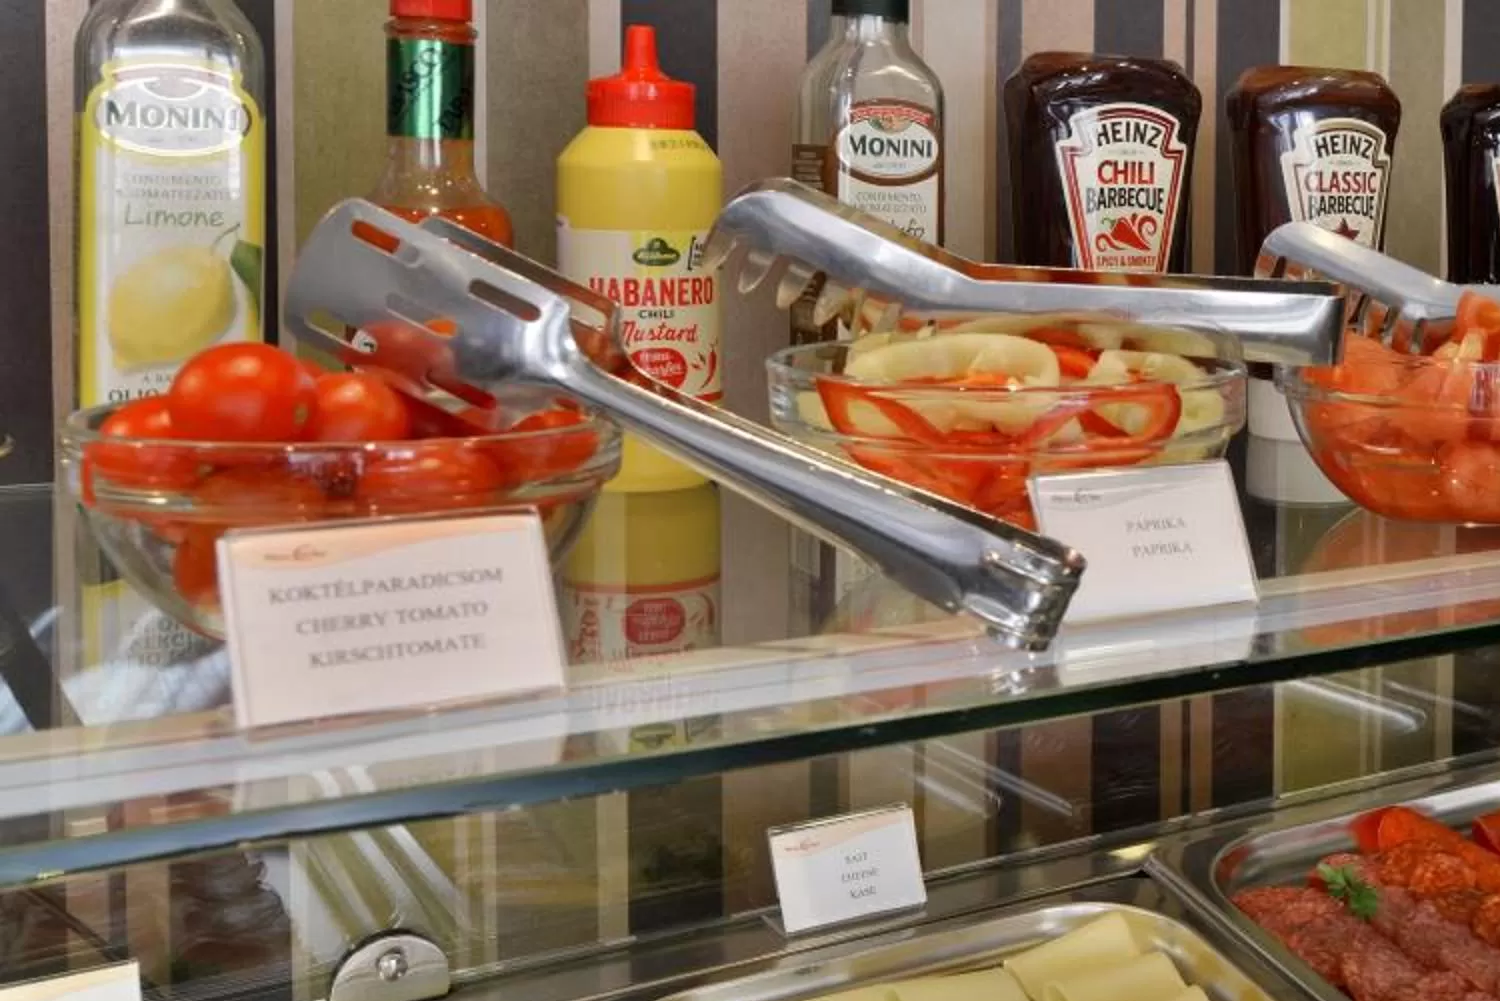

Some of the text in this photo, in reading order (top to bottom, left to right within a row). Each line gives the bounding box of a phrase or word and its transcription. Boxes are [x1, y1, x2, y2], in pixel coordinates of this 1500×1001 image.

[106, 99, 238, 130] MONINI
[849, 134, 933, 159] MONINI
[1096, 120, 1163, 149] HEINZ
[1314, 134, 1373, 159] HEINZ
[1096, 159, 1155, 185] CHILI
[1304, 170, 1377, 194] CLASSIC
[1085, 187, 1165, 214] BARBECUE
[1308, 195, 1375, 220] BARBECUE
[124, 202, 225, 228] Limone
[588, 275, 714, 307] HABANERO
[637, 309, 676, 320] CHILI
[623, 321, 699, 345] Mustard
[268, 566, 505, 605] KOKTÉLPARADICSOM
[296, 601, 489, 635] CHERRY TOMATO
[309, 632, 485, 669] KIRSCHTOMATE
